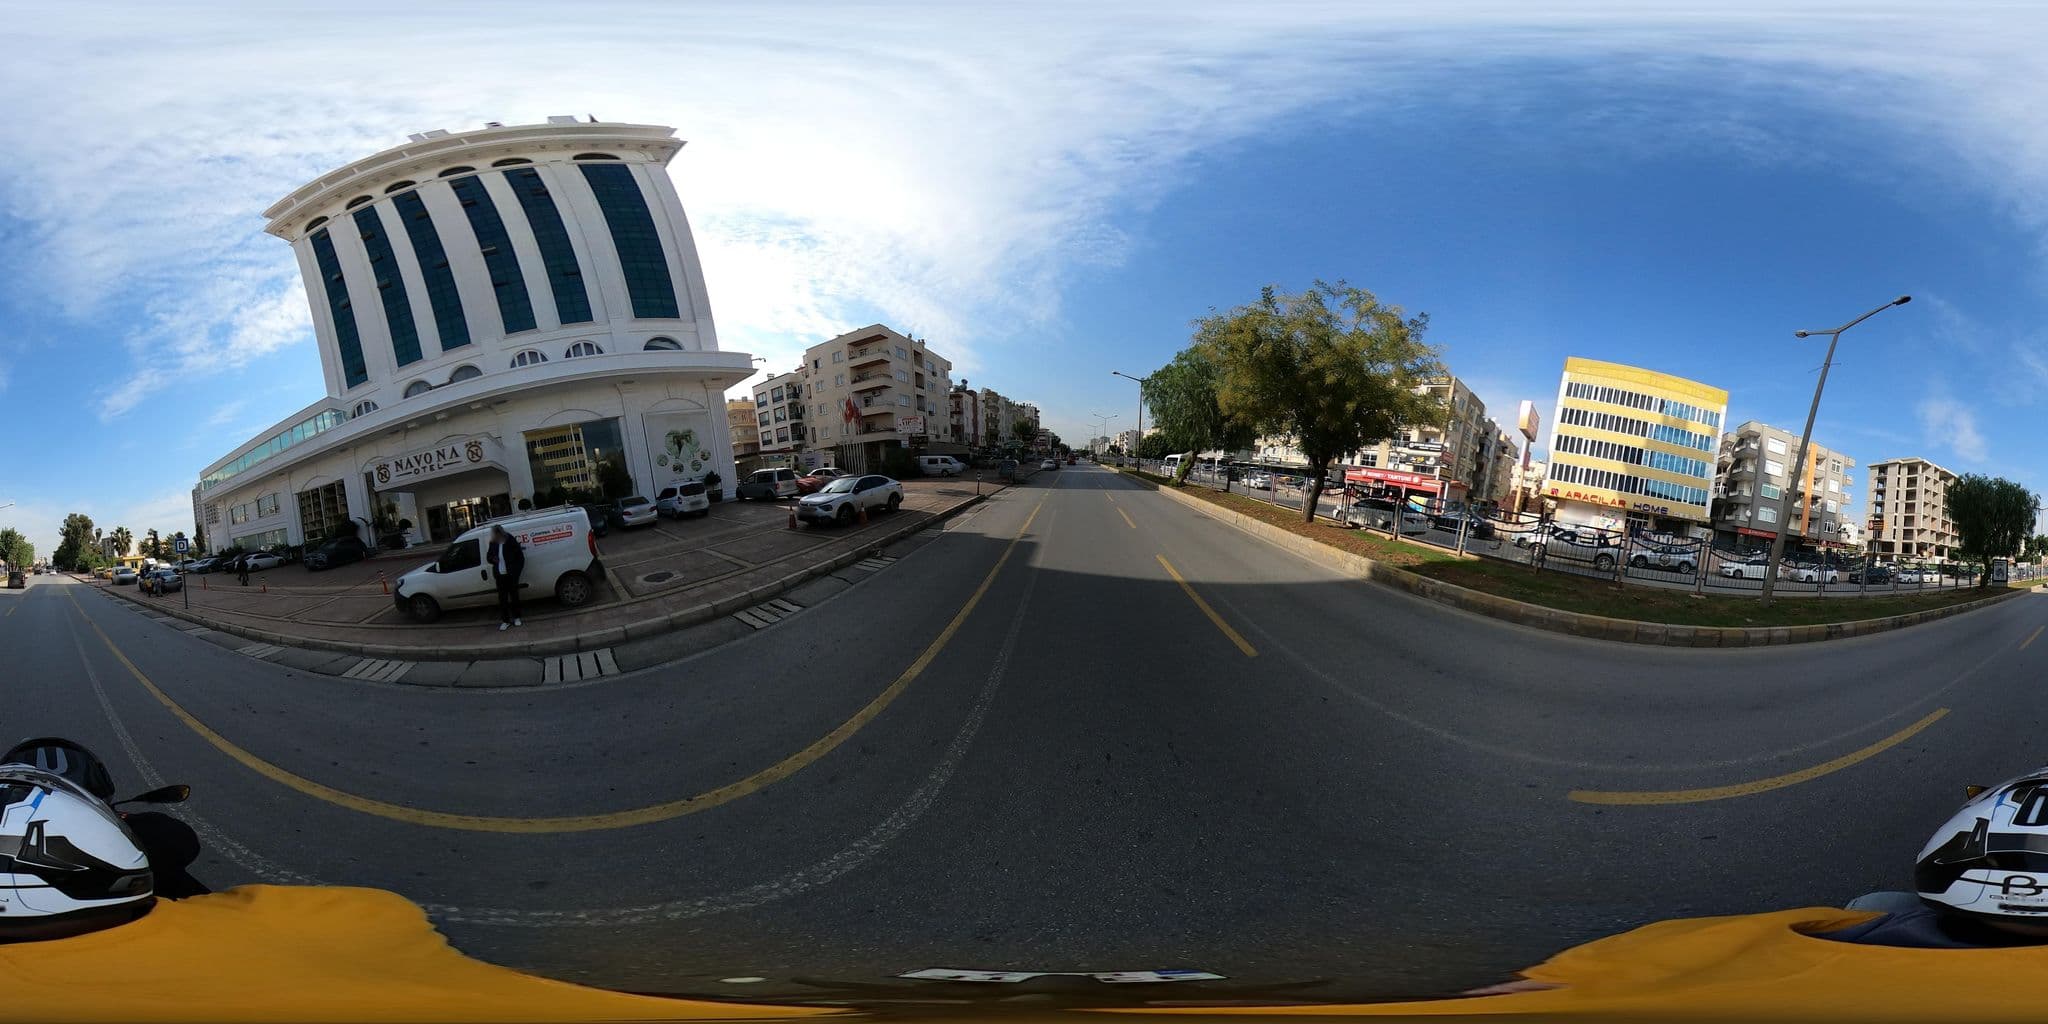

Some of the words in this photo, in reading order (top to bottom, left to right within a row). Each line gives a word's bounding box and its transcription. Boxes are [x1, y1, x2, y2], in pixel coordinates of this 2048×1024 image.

[394, 446, 460, 472] NAVONA
[413, 464, 444, 475] OTEL
[1633, 502, 1669, 515] HOME
